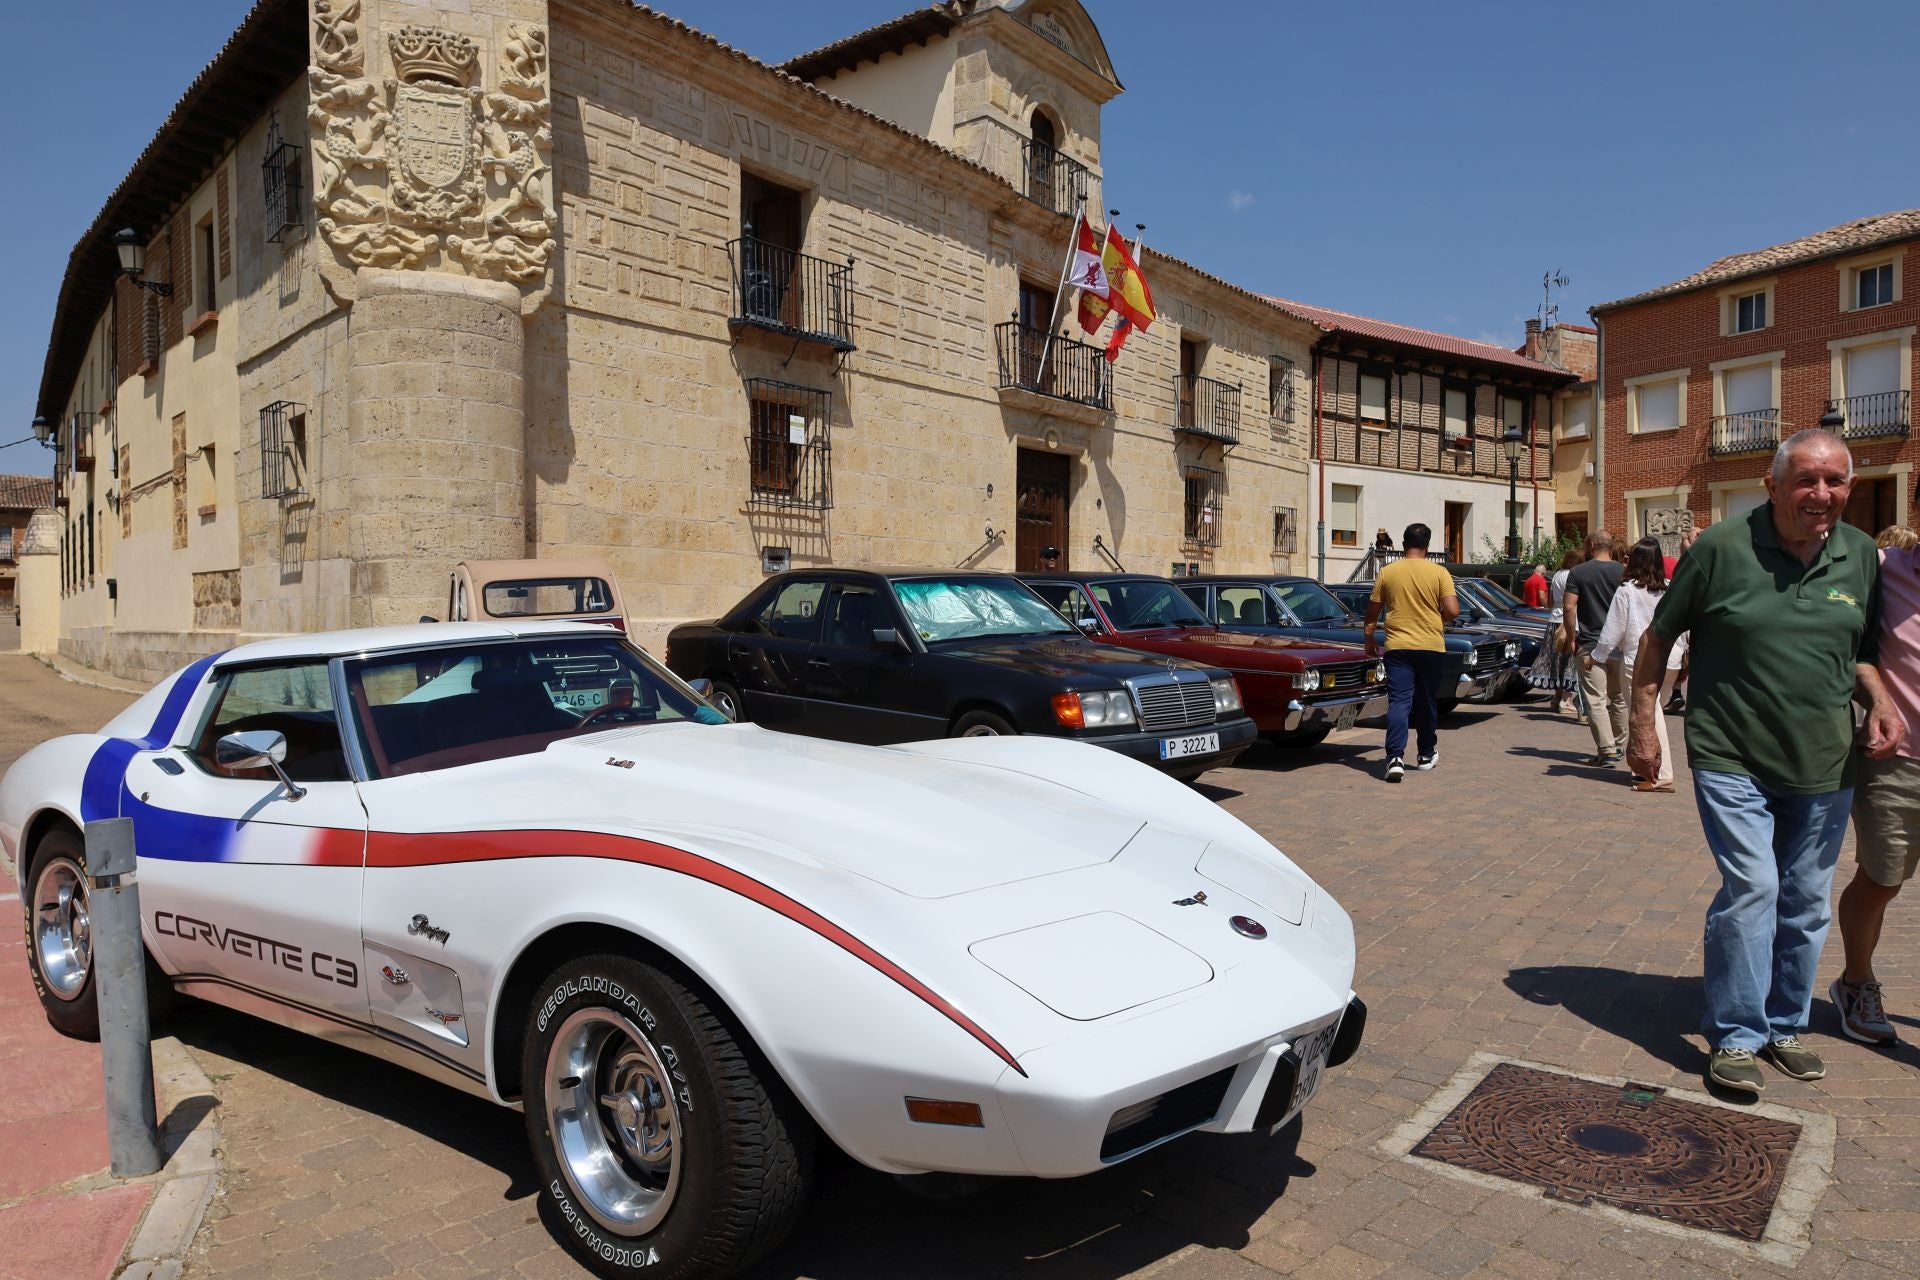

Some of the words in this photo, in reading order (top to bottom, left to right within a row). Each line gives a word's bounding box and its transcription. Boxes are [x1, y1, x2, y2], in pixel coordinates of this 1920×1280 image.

[1045, 19, 1061, 35] CASA
[1169, 740, 1176, 756] P
[1181, 736, 1206, 754] 3222
[1209, 734, 1216, 750] K
[154, 910, 304, 973] CORVETTE
[311, 951, 358, 989] C3
[537, 976, 657, 1032] GEOLANDAR
[661, 1045, 694, 1112] A/T
[550, 1179, 660, 1268] YOKOHAMA
